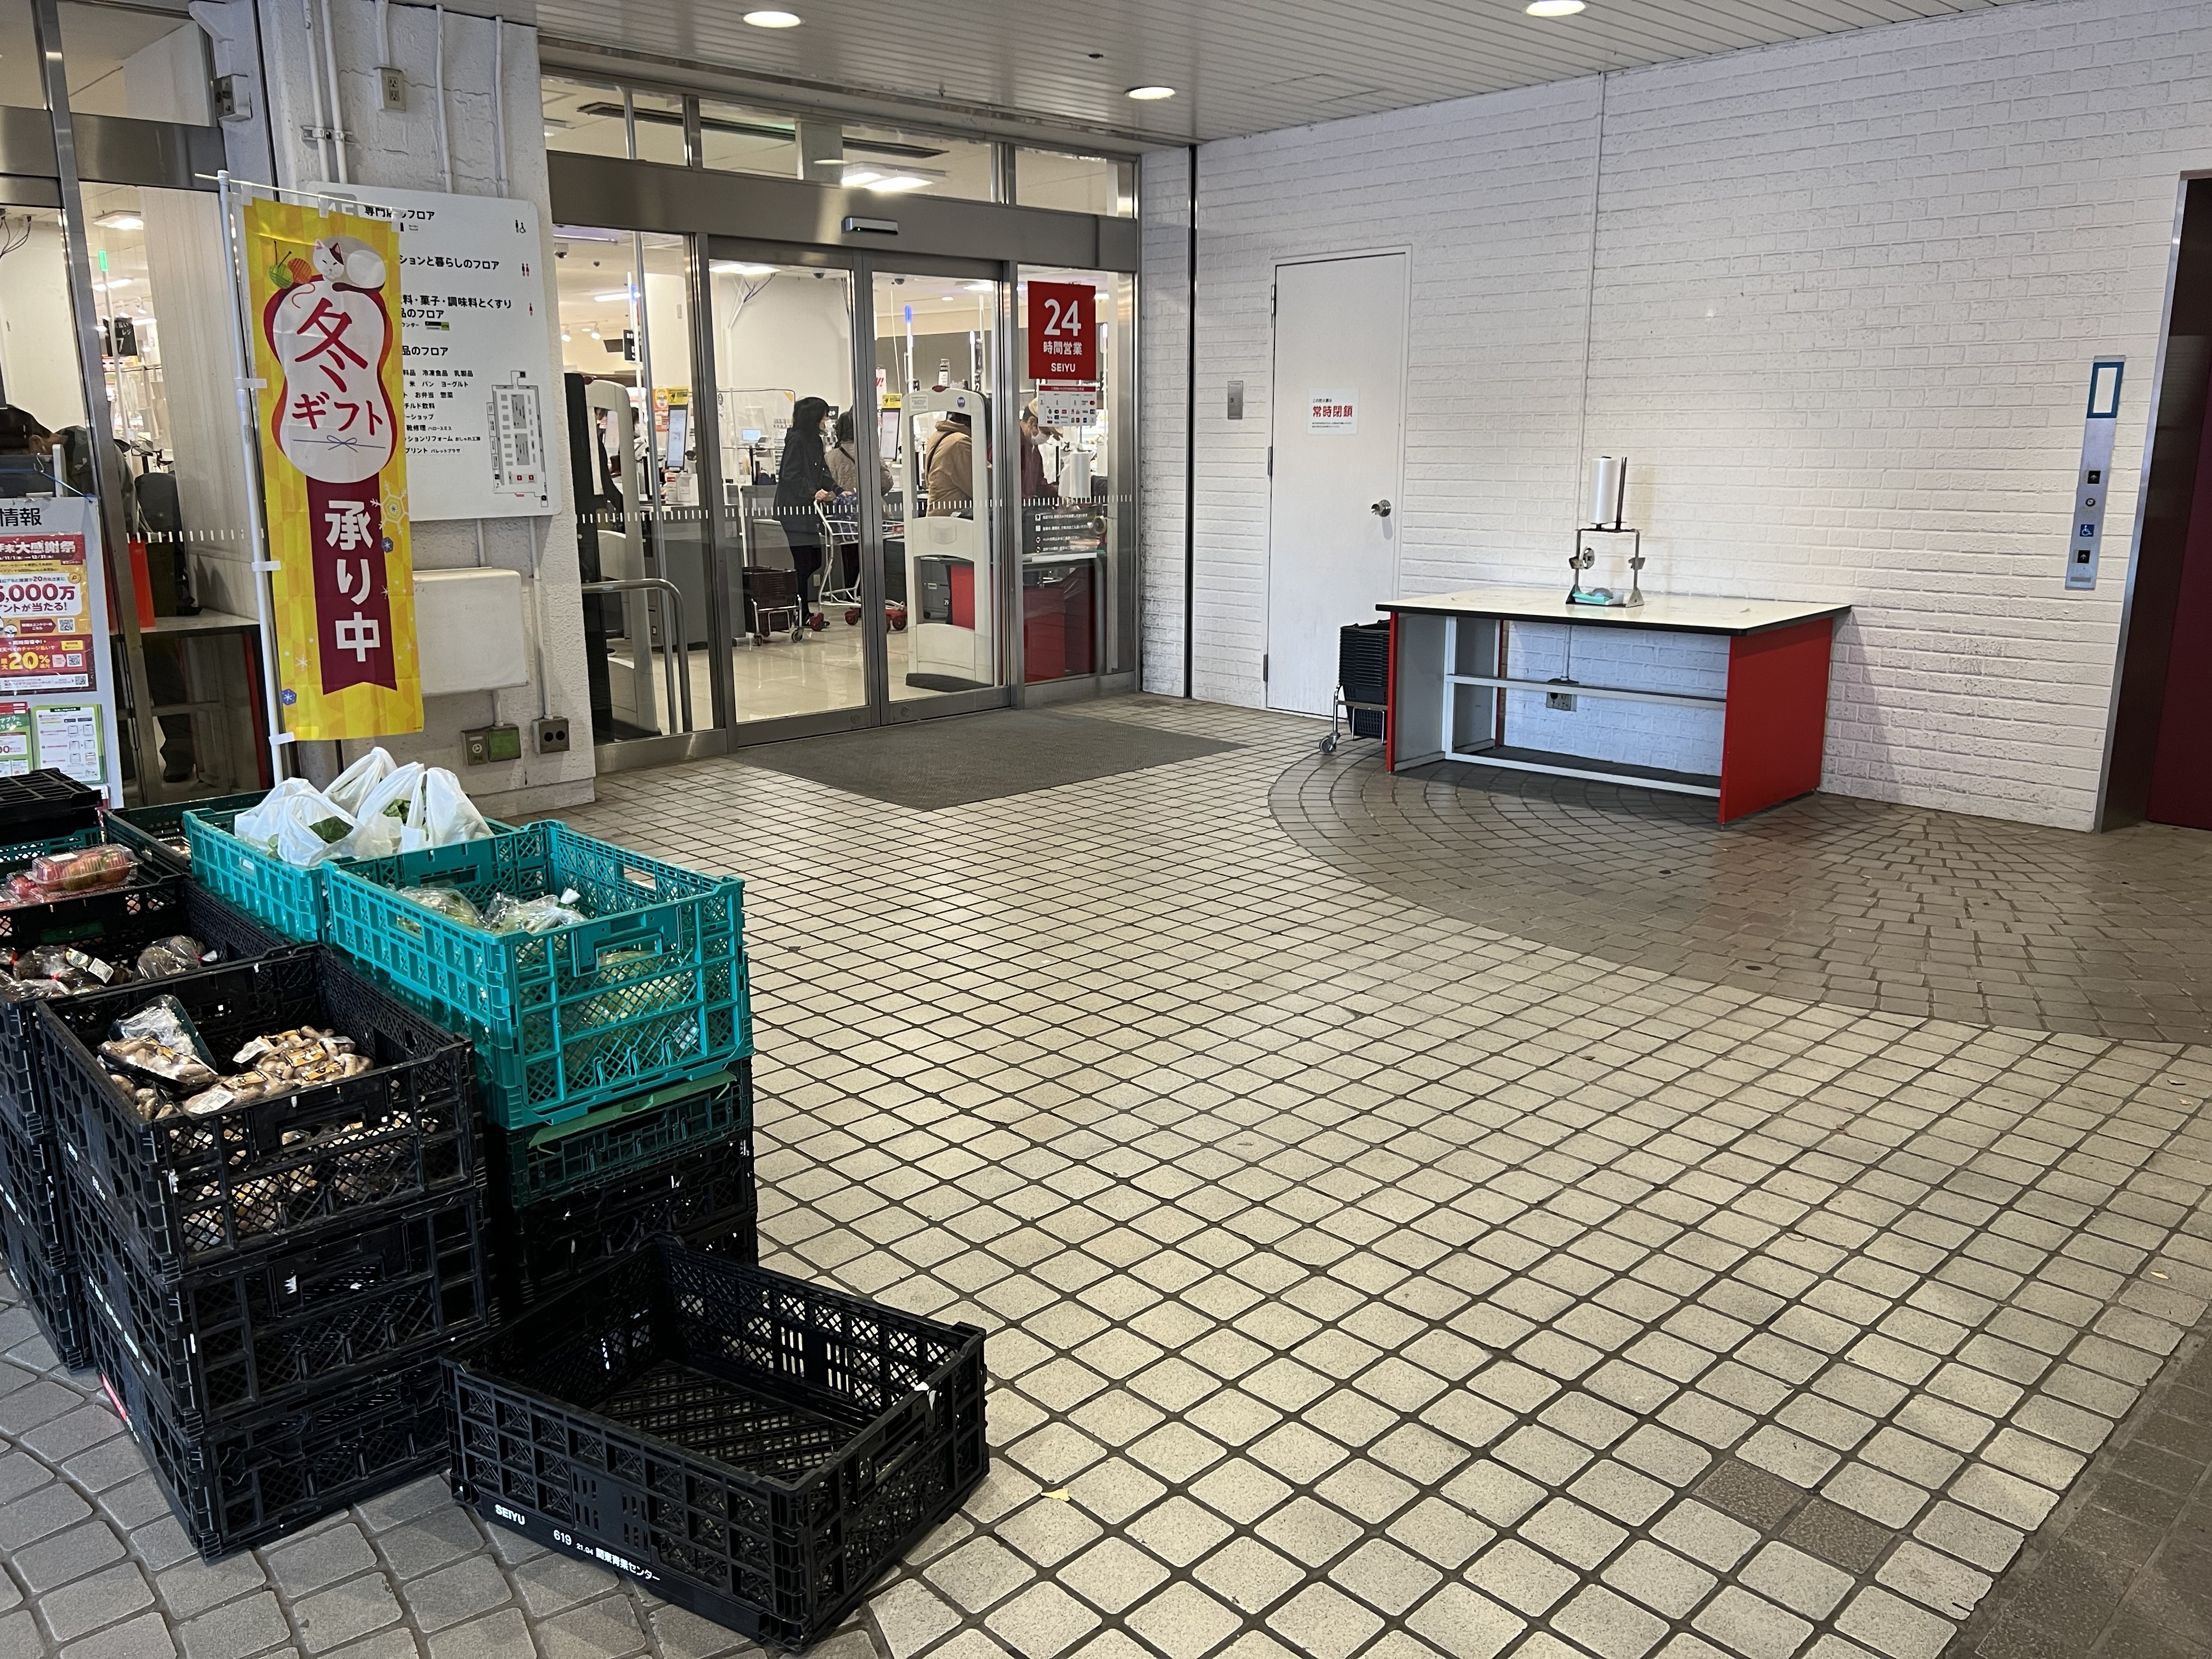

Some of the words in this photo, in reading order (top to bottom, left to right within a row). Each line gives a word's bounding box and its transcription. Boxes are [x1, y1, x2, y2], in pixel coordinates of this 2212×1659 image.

[401, 294, 511, 309] 料・菓子・調味料とくすり
[1043, 298, 1082, 337] 24
[295, 297, 369, 393] 冬
[1043, 340, 1082, 356] 時間営業
[1051, 363, 1076, 373] SEIYU
[292, 391, 384, 436] ギフト
[1313, 405, 1353, 417] 常時閉鎖
[0, 507, 42, 527] 情報
[325, 499, 381, 662] 承り中
[0, 602, 67, 613] ントが当たる!
[495, 1504, 526, 1525] SEIYU
[554, 1530, 572, 1545] 619
[596, 1547, 661, 1581] 関東青果センター
